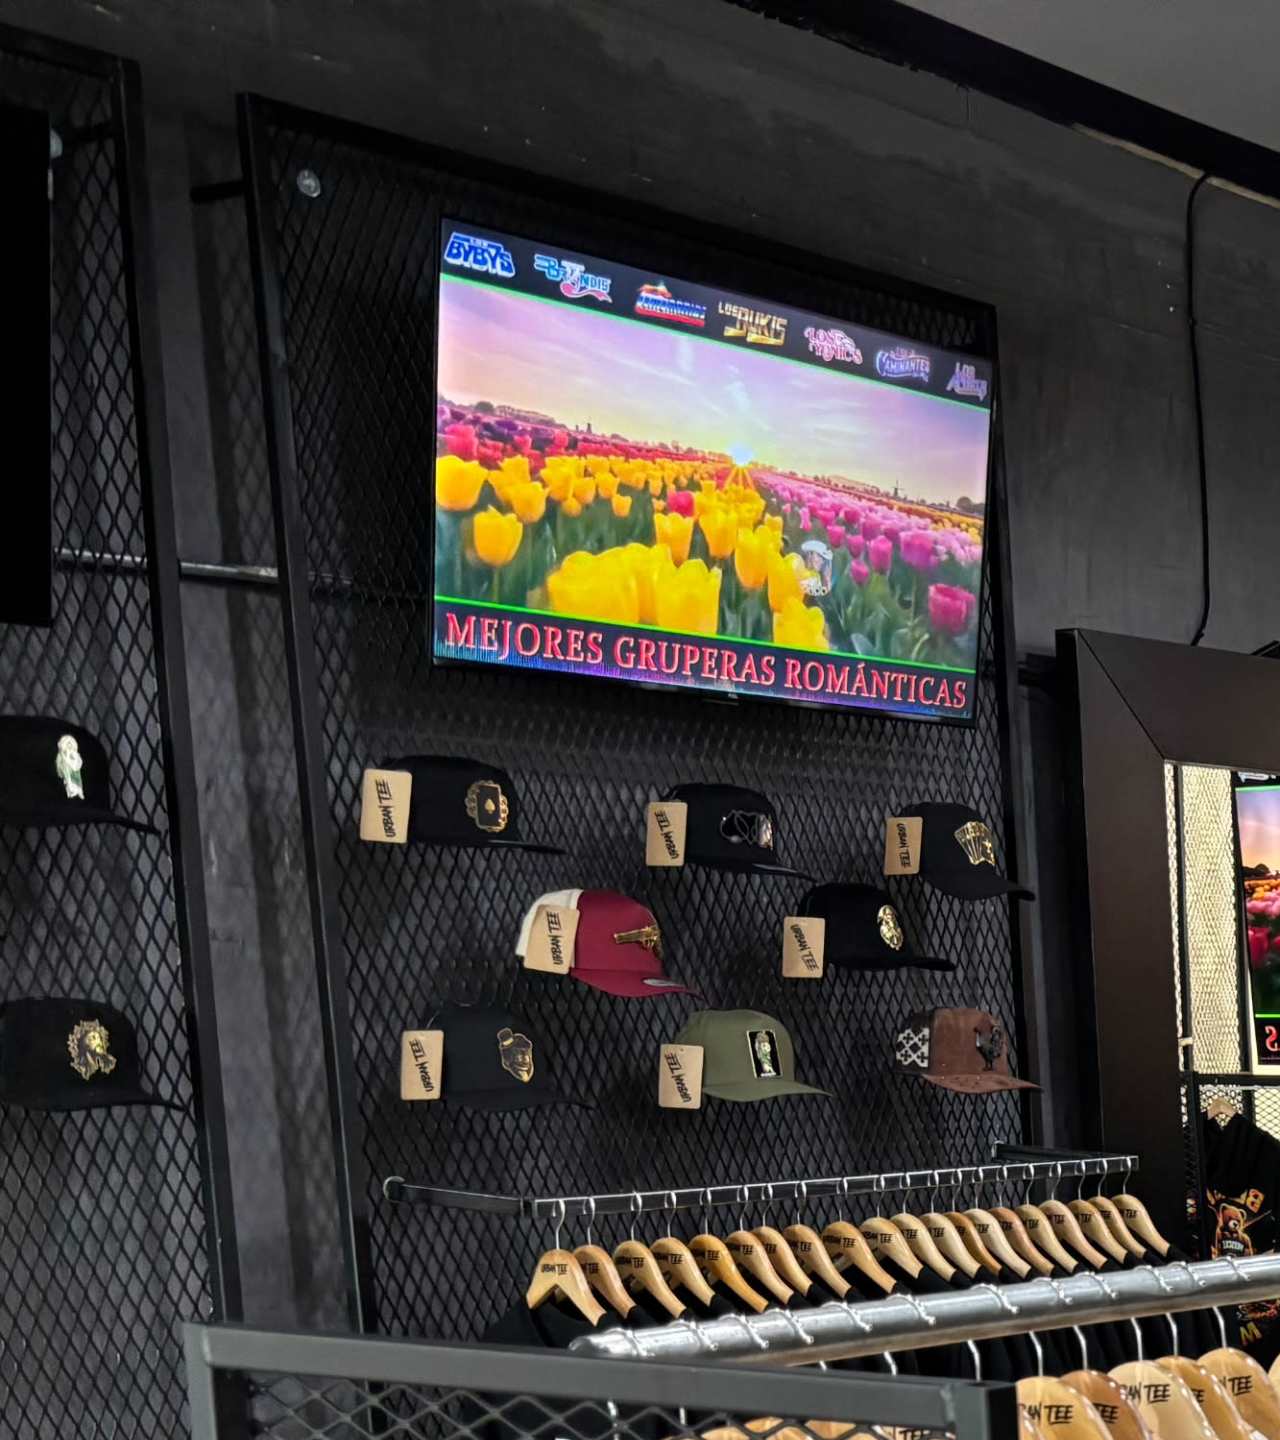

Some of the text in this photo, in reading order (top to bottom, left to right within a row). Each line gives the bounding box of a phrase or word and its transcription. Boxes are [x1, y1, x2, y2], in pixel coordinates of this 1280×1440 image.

[446, 612, 967, 709] MEJORES GRUPERAS ROMÁNTICAS
[374, 778, 396, 838] URBAN TEE
[547, 911, 564, 966] URBAN TEE
[1146, 1383, 1171, 1404] TEE
[1229, 1375, 1253, 1396] TEE
[1044, 1405, 1073, 1425] TEE
